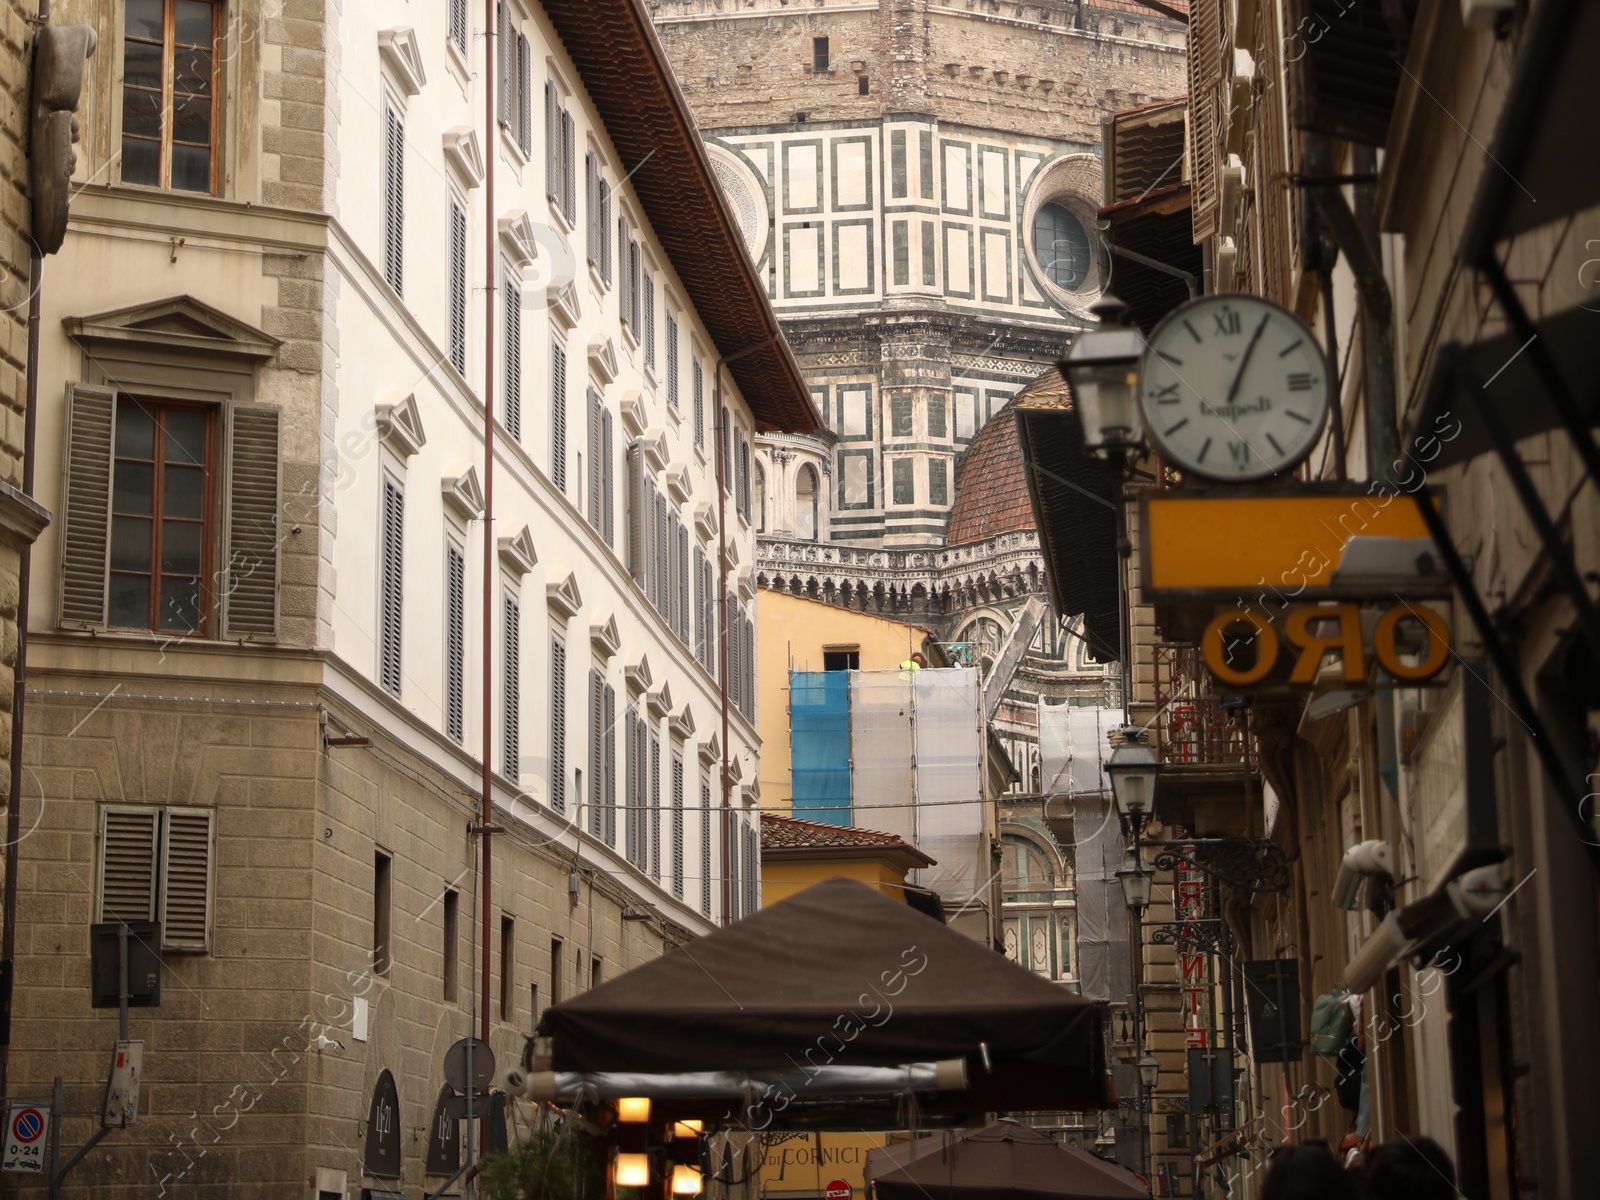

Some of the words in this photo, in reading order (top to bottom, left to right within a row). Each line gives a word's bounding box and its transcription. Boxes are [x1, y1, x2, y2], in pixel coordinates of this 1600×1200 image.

[1213, 312, 1241, 335] XII
[10, 1144, 39, 1156] 0-24
[768, 1156, 781, 1165] DI
